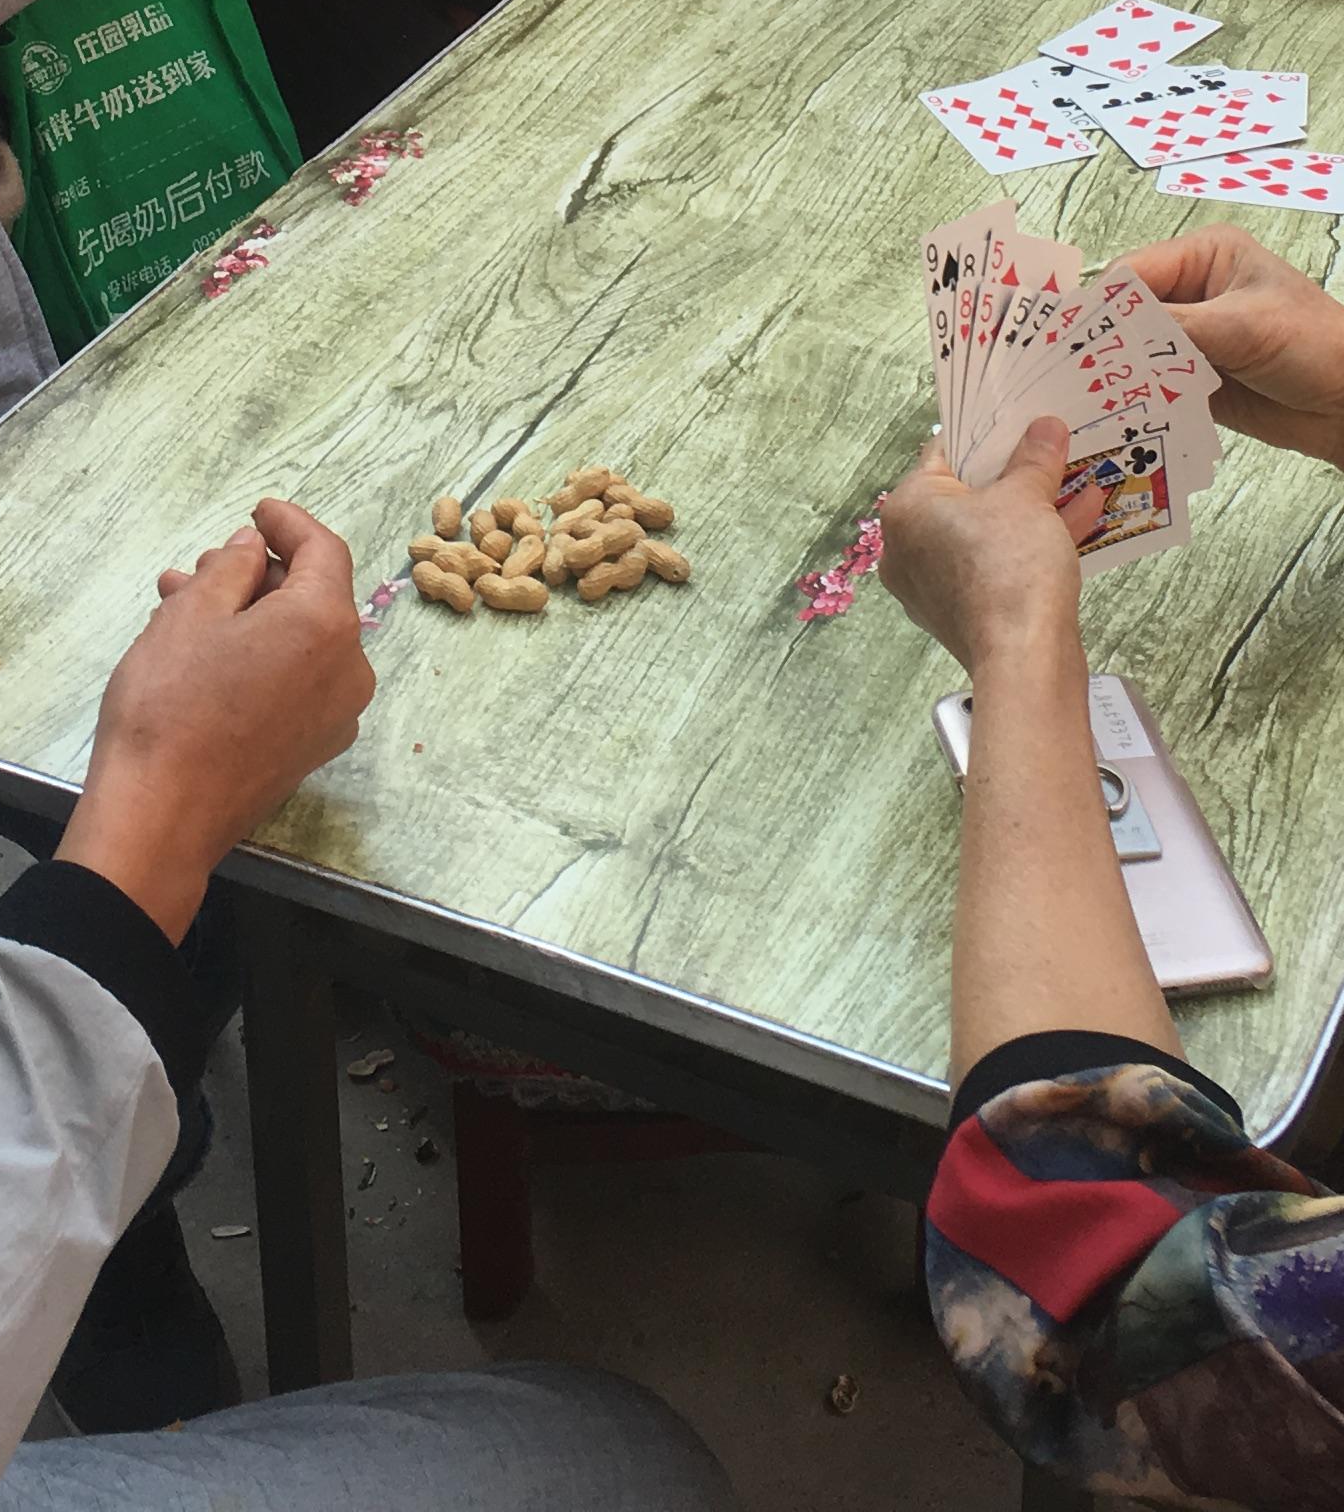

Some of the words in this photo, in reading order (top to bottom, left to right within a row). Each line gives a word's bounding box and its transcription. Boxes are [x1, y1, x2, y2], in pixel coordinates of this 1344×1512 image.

[73, 1, 174, 65] 庄园乳品
[1278, 74, 1301, 83] 3
[76, 149, 271, 276] 先喝奶后付款
[926, 243, 939, 272] 9
[991, 240, 1004, 270] 5
[960, 289, 972, 319] 8
[1104, 282, 1129, 303] 4
[980, 293, 993, 323] 5
[1012, 296, 1032, 325] 5
[1060, 304, 1083, 328] 4
[936, 310, 948, 339] 9
[1087, 315, 1115, 341] 3
[1096, 334, 1125, 355] 7
[1148, 340, 1177, 358] 7
[1105, 364, 1133, 386] 2
[1167, 359, 1195, 375] 7
[1122, 382, 1152, 407] K
[1142, 421, 1170, 434] J
